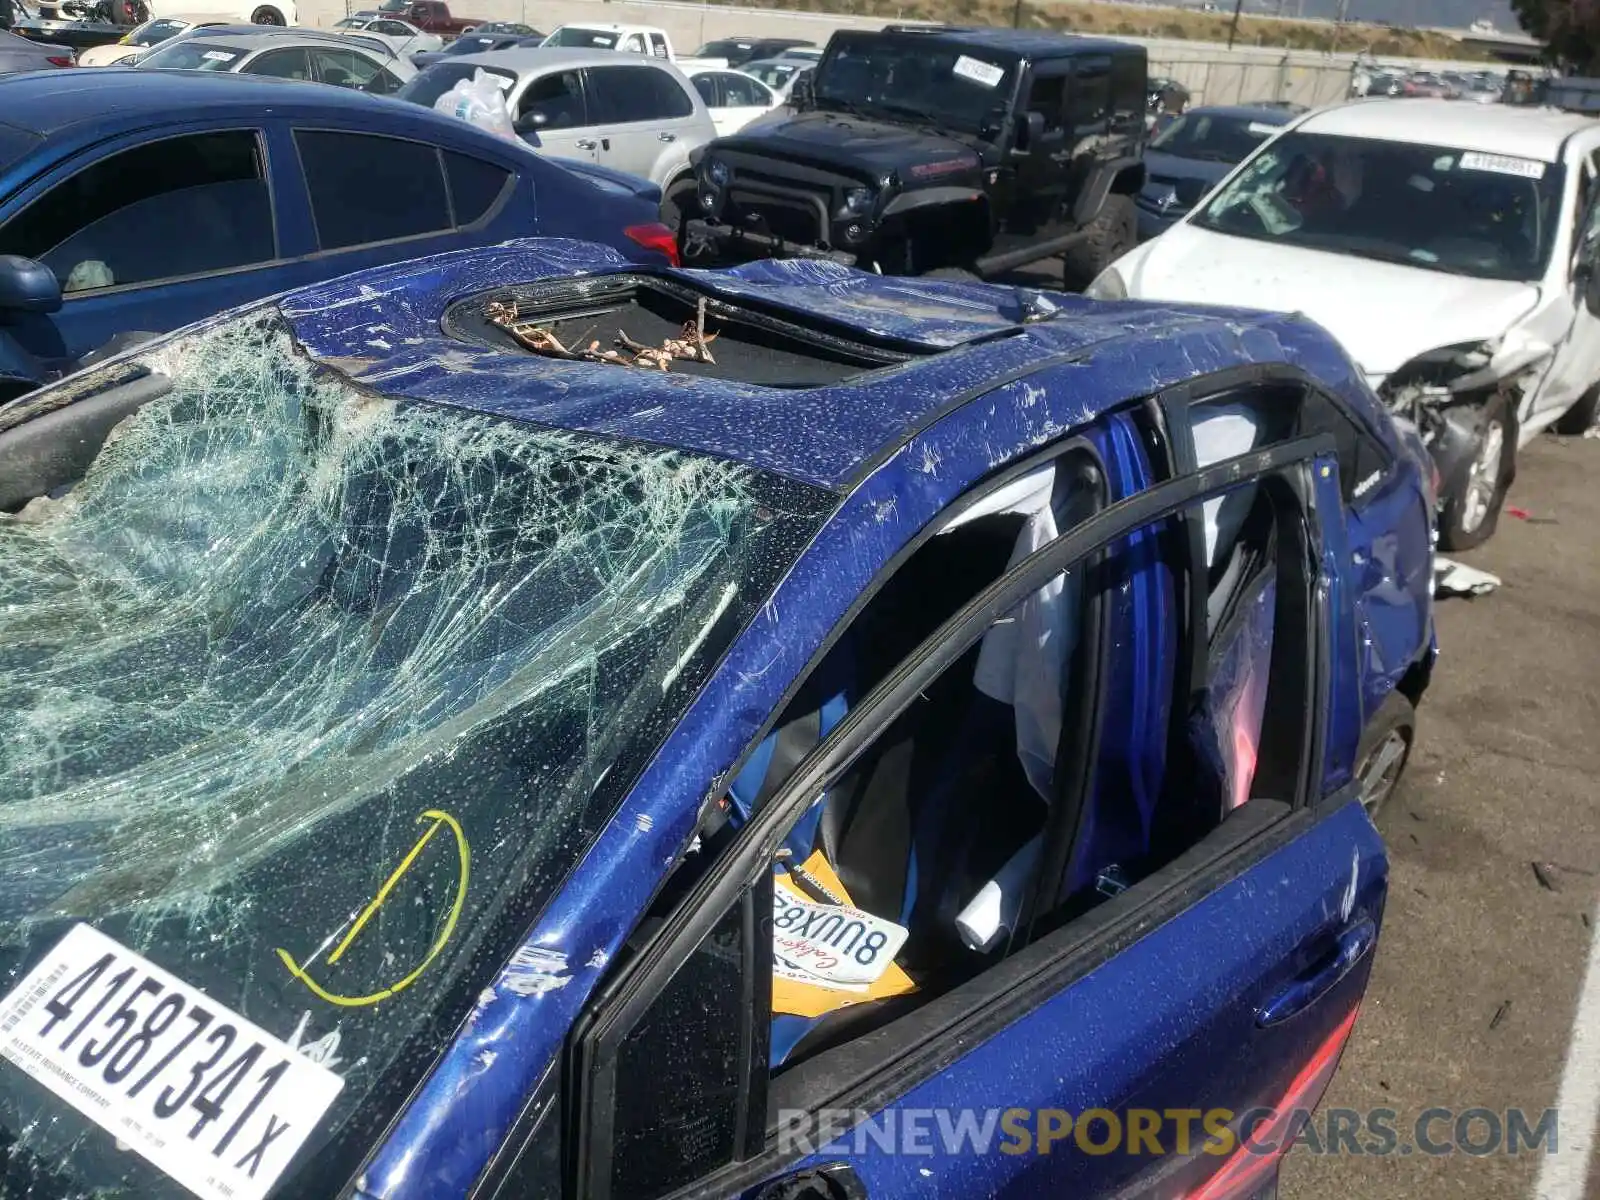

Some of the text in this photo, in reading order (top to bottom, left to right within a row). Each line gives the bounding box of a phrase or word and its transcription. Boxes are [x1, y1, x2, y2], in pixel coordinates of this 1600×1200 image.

[11, 1037, 43, 1060] ALLSTATE
[40, 1056, 79, 1088] INSURANCE
[76, 1081, 112, 1110] COMPANY
